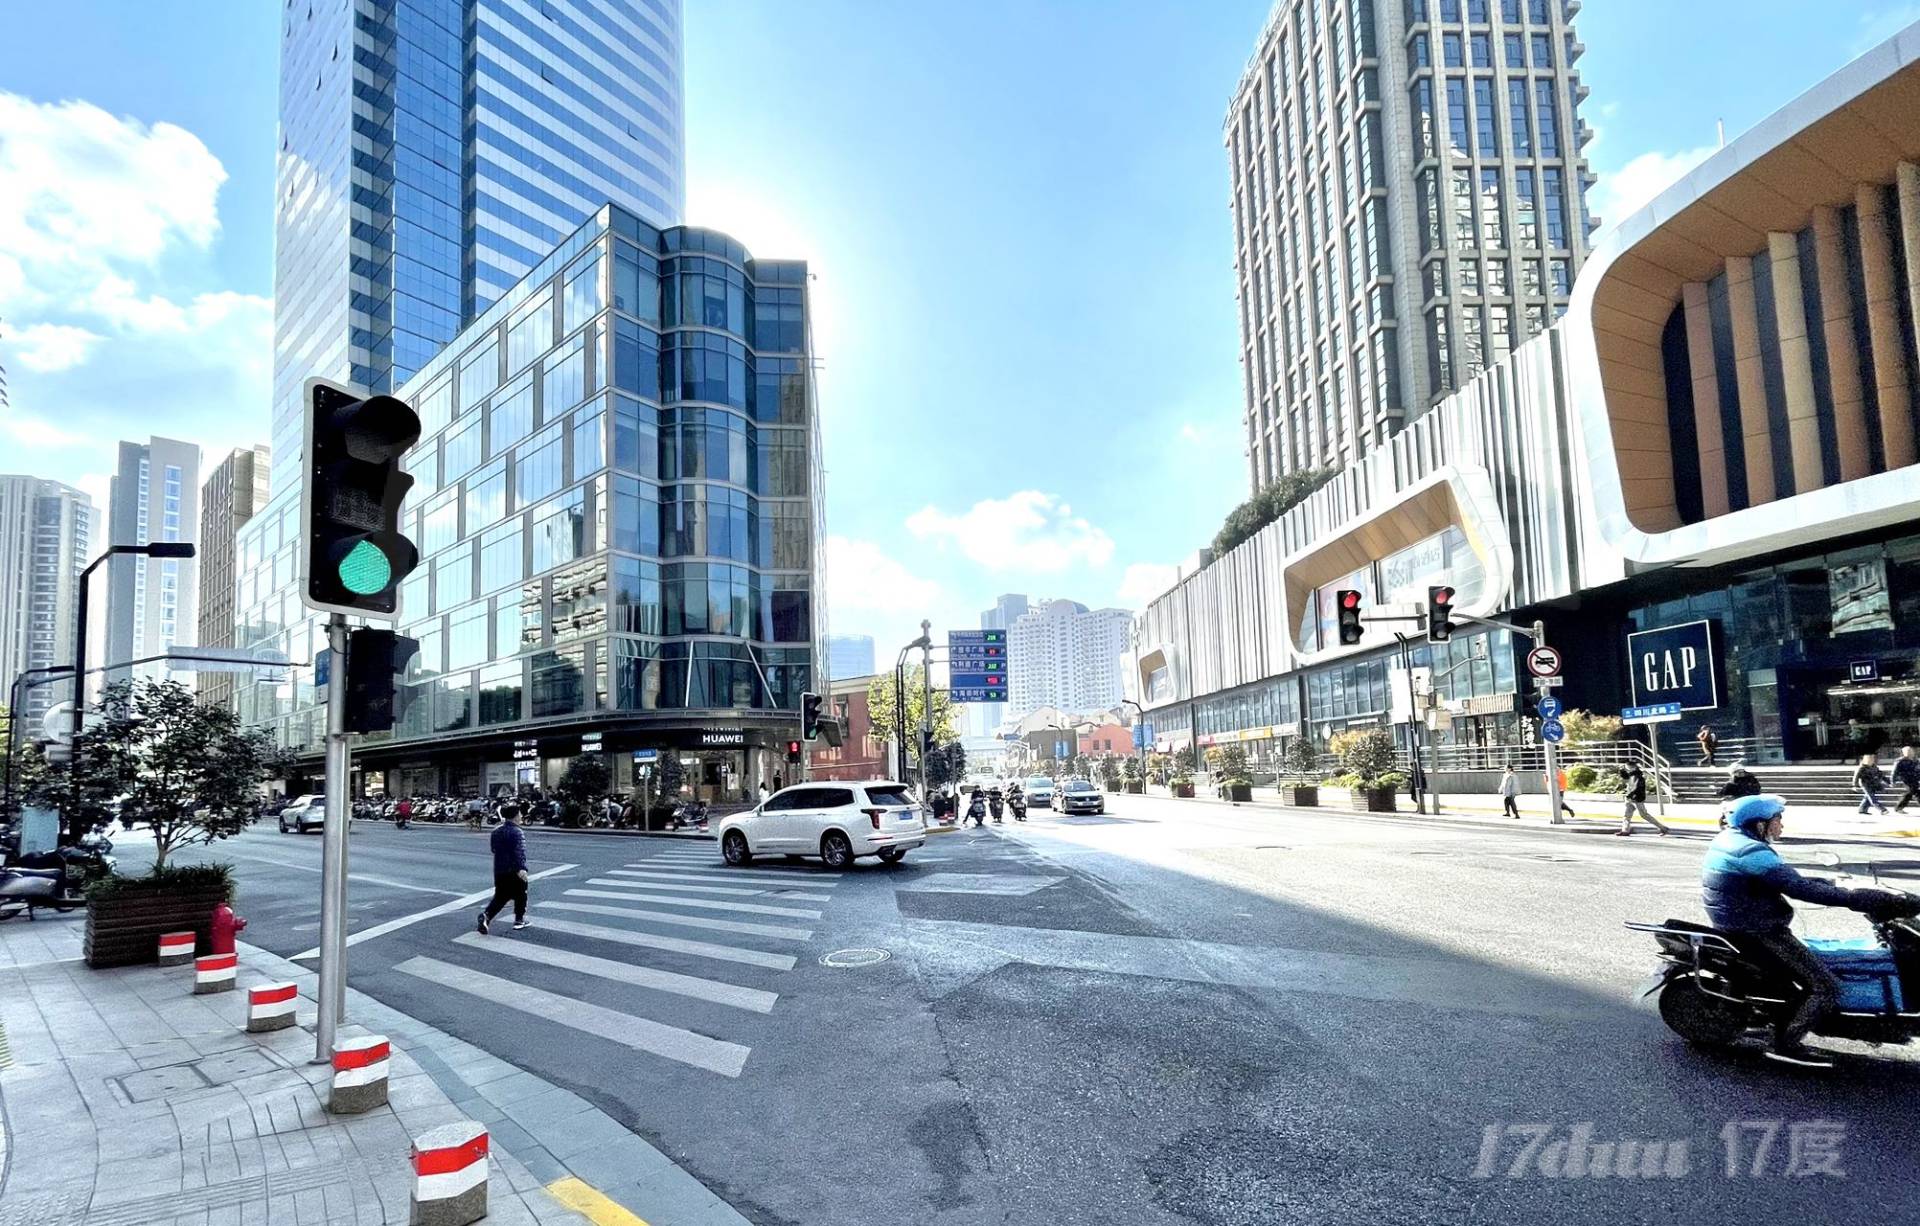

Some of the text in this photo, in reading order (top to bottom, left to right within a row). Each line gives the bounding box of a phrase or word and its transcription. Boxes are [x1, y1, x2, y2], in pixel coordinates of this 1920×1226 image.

[1643, 646, 1697, 692] GAP
[1855, 665, 1872, 676] GAP
[702, 734, 744, 743] HUAWEI
